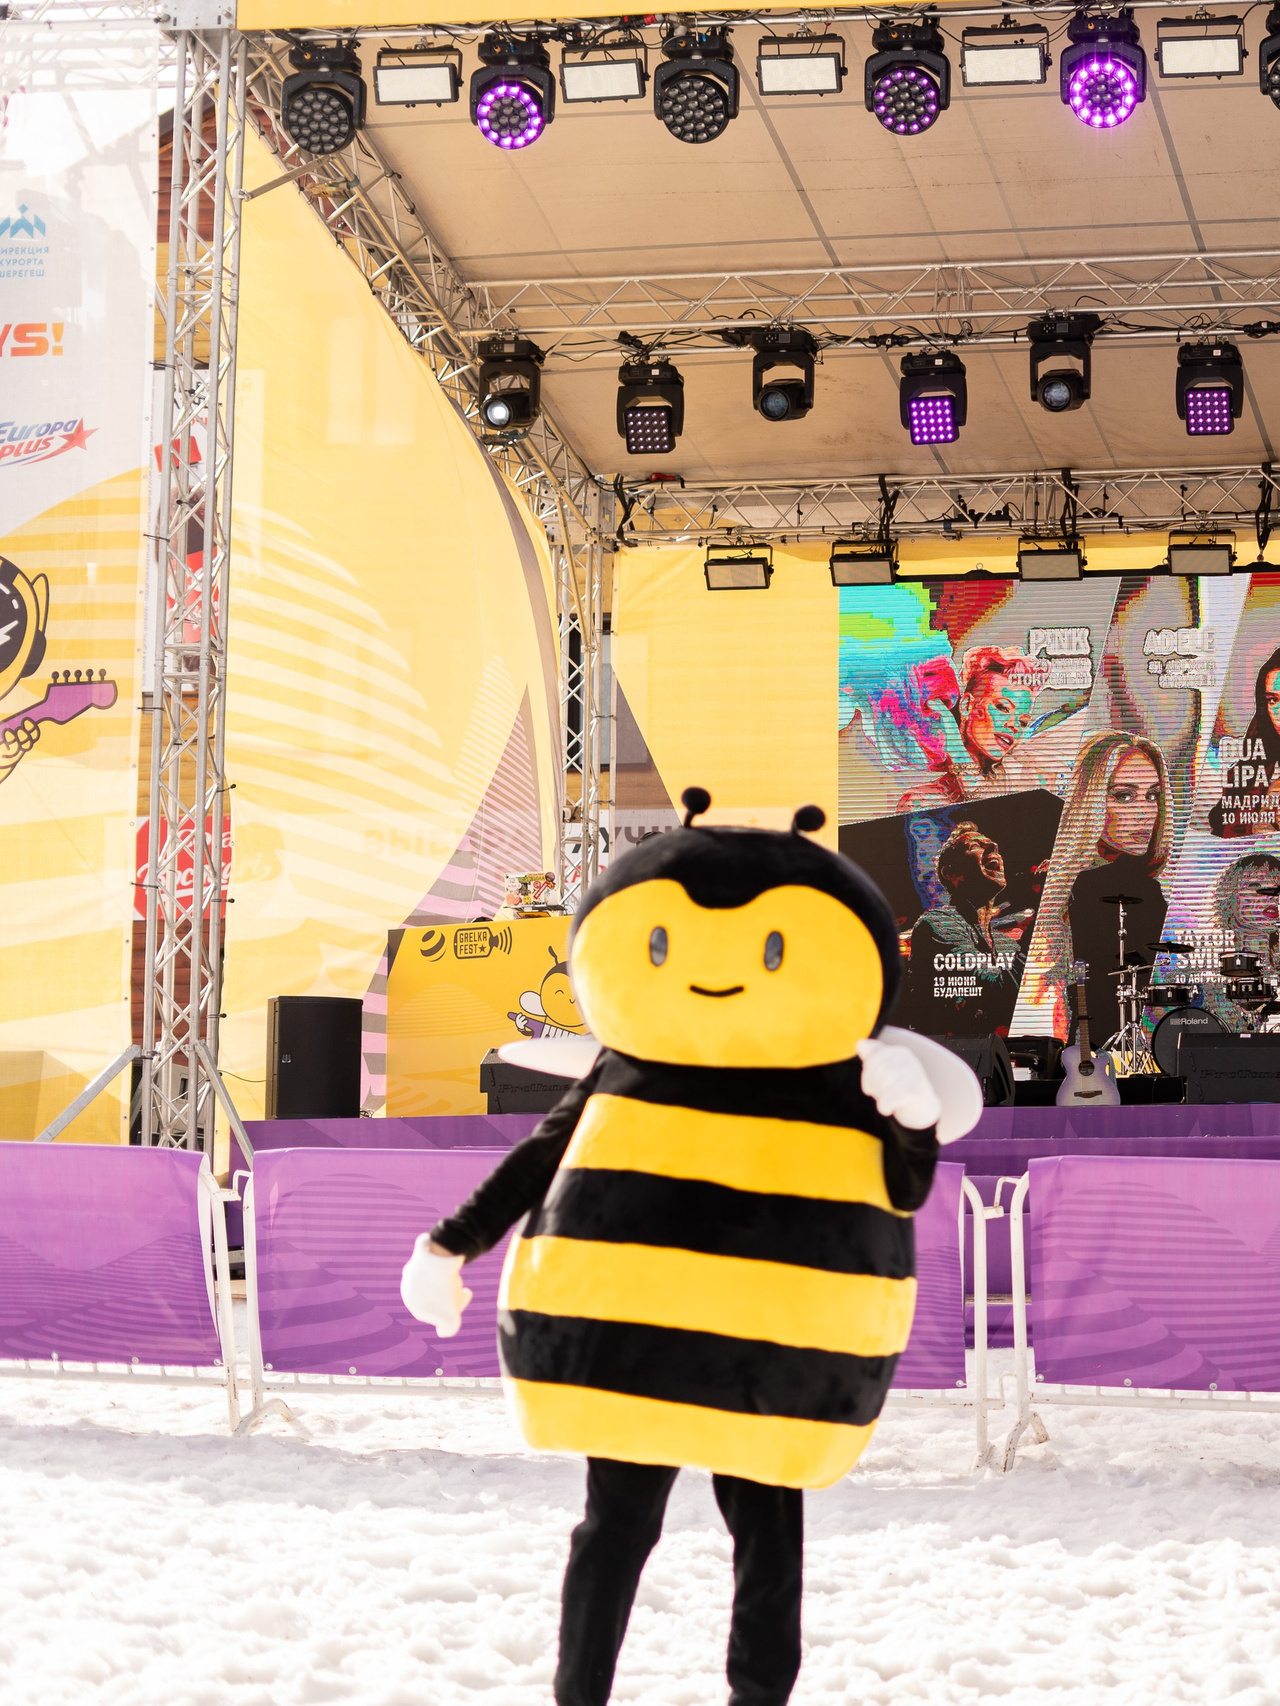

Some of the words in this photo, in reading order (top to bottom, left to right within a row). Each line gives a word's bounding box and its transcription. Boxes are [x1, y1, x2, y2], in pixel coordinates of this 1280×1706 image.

[0, 246, 49, 256] ИРЕКЦИЯ
[1221, 738, 1267, 761] DUA
[1222, 765, 1270, 788] LIPA
[1221, 795, 1280, 810] МАДРИД
[1222, 813, 1236, 825] 10
[1240, 811, 1276, 824] ИЮЛЯ
[459, 931, 488, 944] GRELKA
[459, 943, 478, 955] FEST
[933, 952, 1016, 971] COLDPLAY
[933, 976, 945, 987] 19
[948, 976, 976, 987] ИЮНЯ
[1175, 974, 1186, 984] 10
[933, 987, 984, 998] БУДАПЕШТ
[1181, 1017, 1209, 1025] Roland
